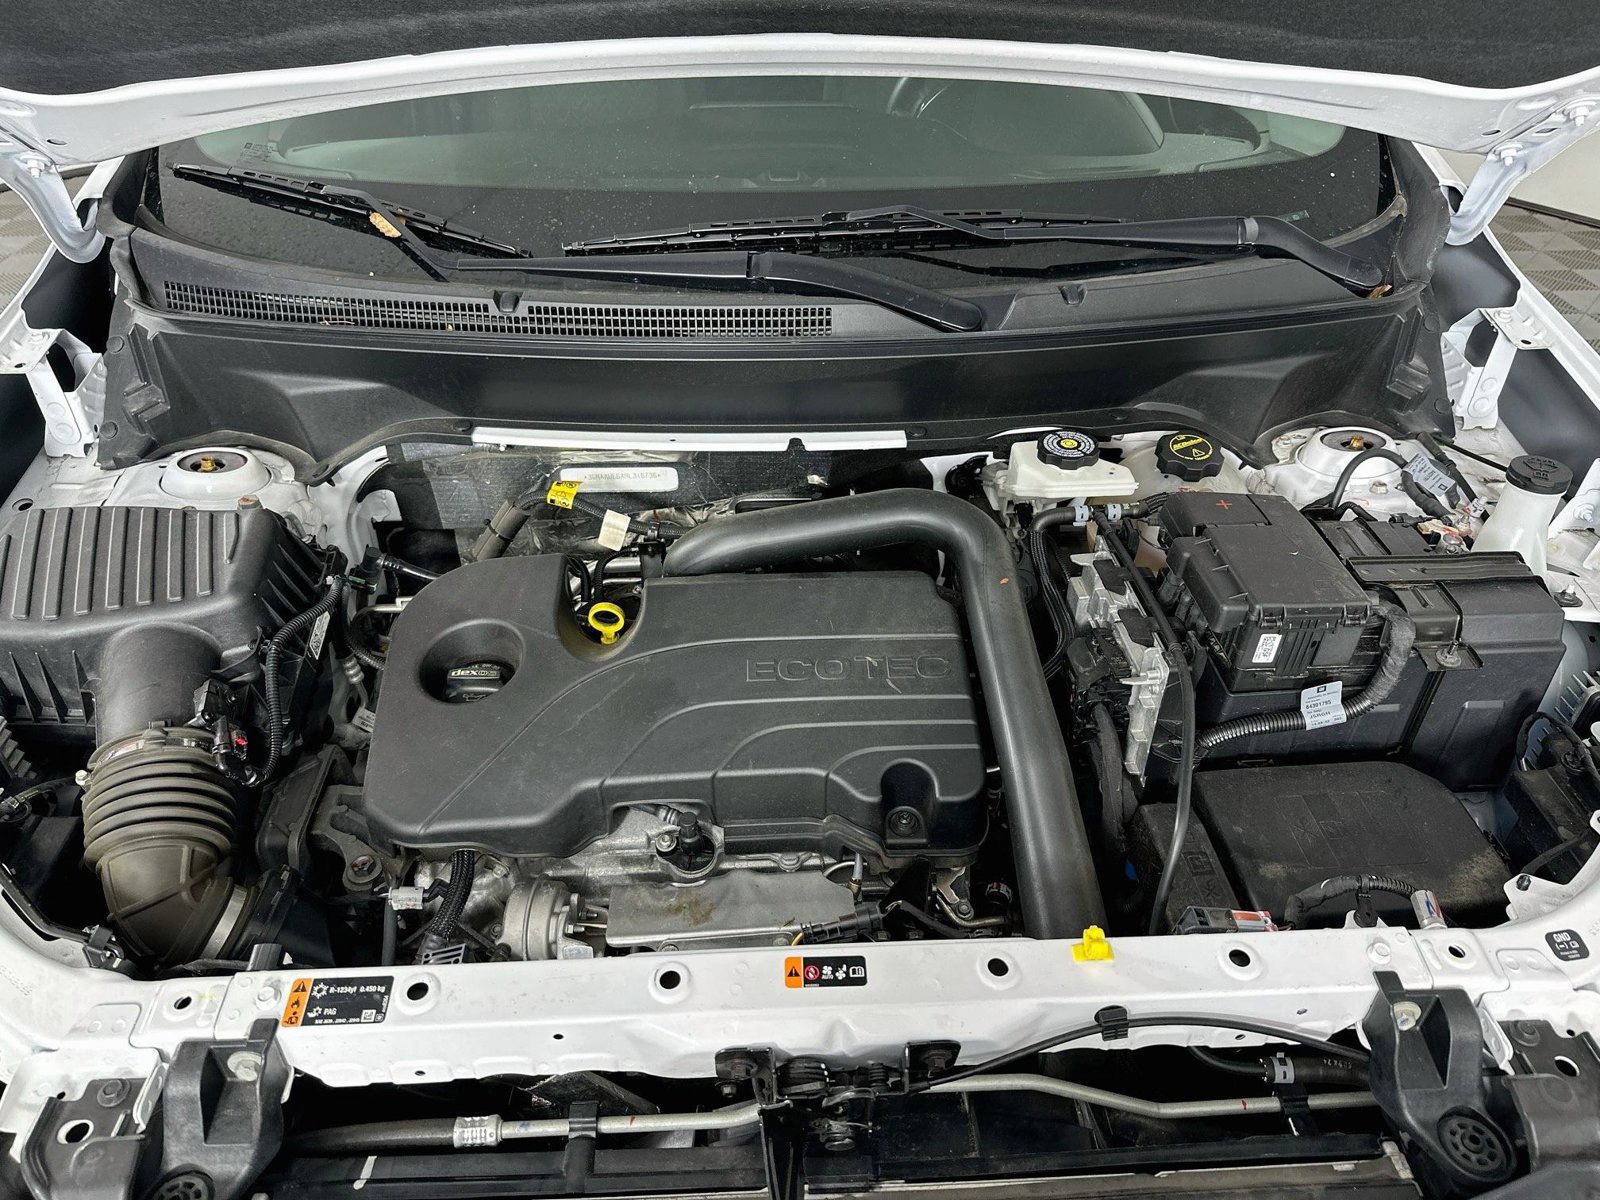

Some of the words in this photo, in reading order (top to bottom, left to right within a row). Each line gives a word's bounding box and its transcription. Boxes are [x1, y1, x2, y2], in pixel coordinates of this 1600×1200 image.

[746, 655, 950, 683] ECOTEC
[1553, 932, 1571, 942] GND
[323, 1008, 337, 1016] PAG
